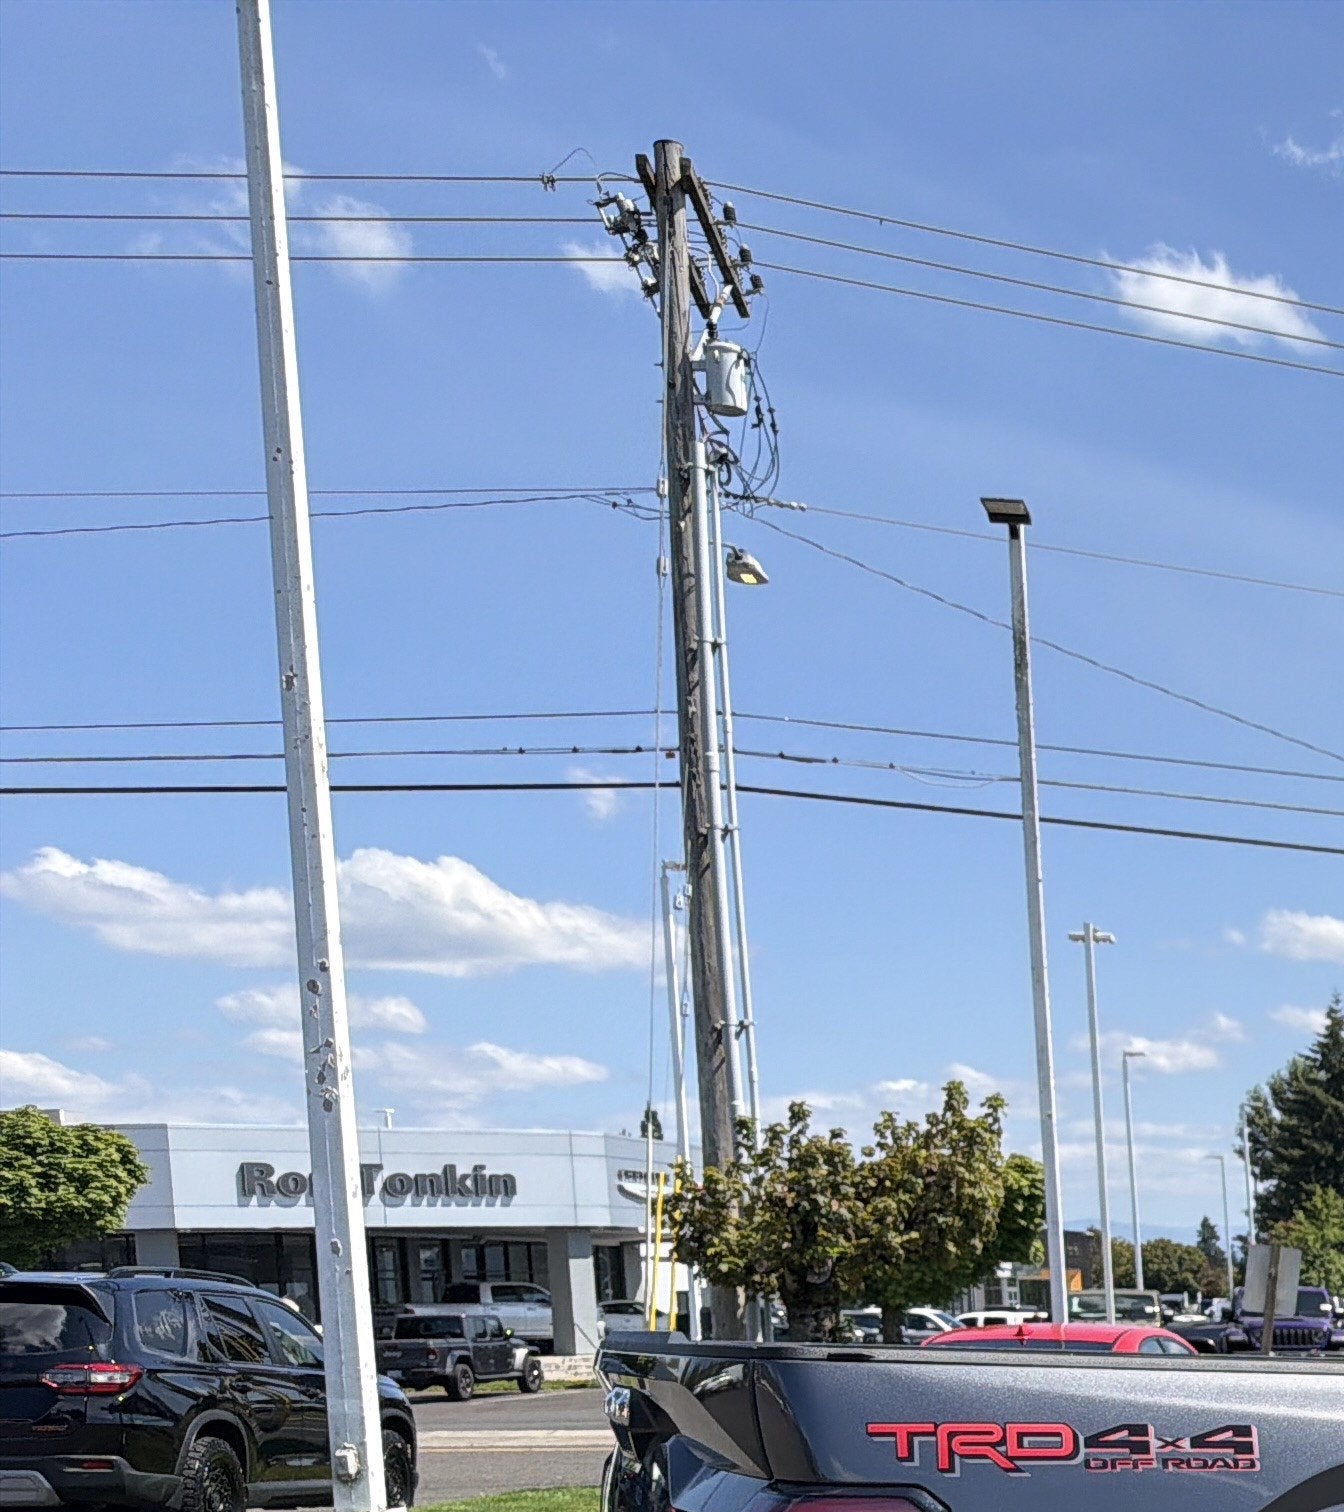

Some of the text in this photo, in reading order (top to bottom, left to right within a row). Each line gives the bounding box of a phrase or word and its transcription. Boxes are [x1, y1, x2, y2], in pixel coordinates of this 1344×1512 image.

[236, 1162, 518, 1201] Ro Tonkin
[866, 1421, 1260, 1476] TRD 4x4
[1082, 1456, 1261, 1473] OFF ROAD
